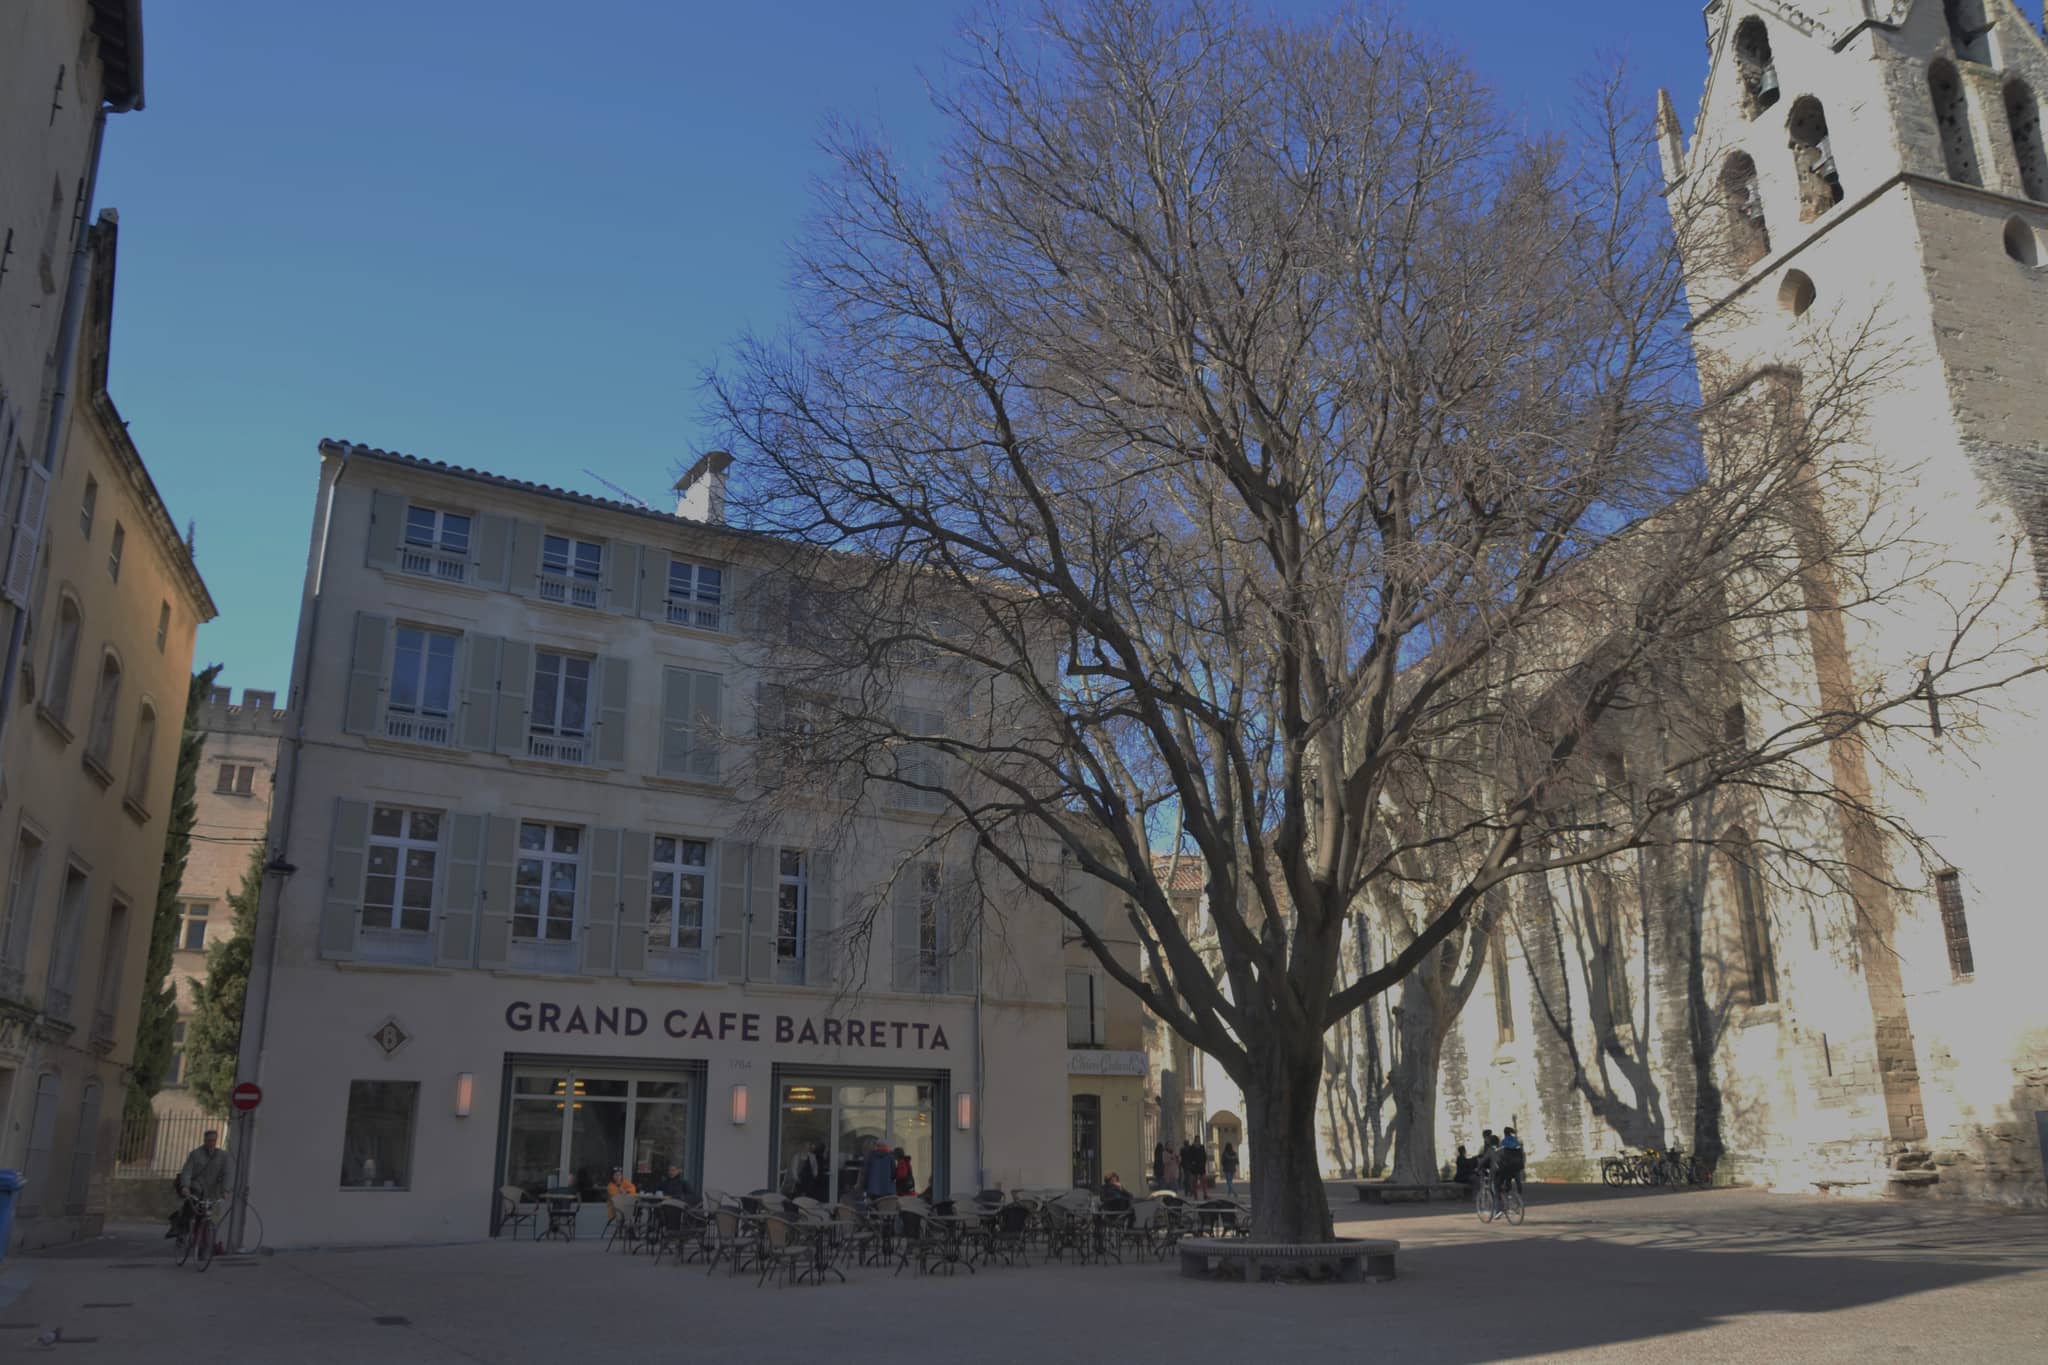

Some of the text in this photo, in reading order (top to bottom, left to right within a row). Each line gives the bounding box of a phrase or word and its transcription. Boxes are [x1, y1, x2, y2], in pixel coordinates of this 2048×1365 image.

[505, 1001, 951, 1051] GRAND CAFE BARRETTA
